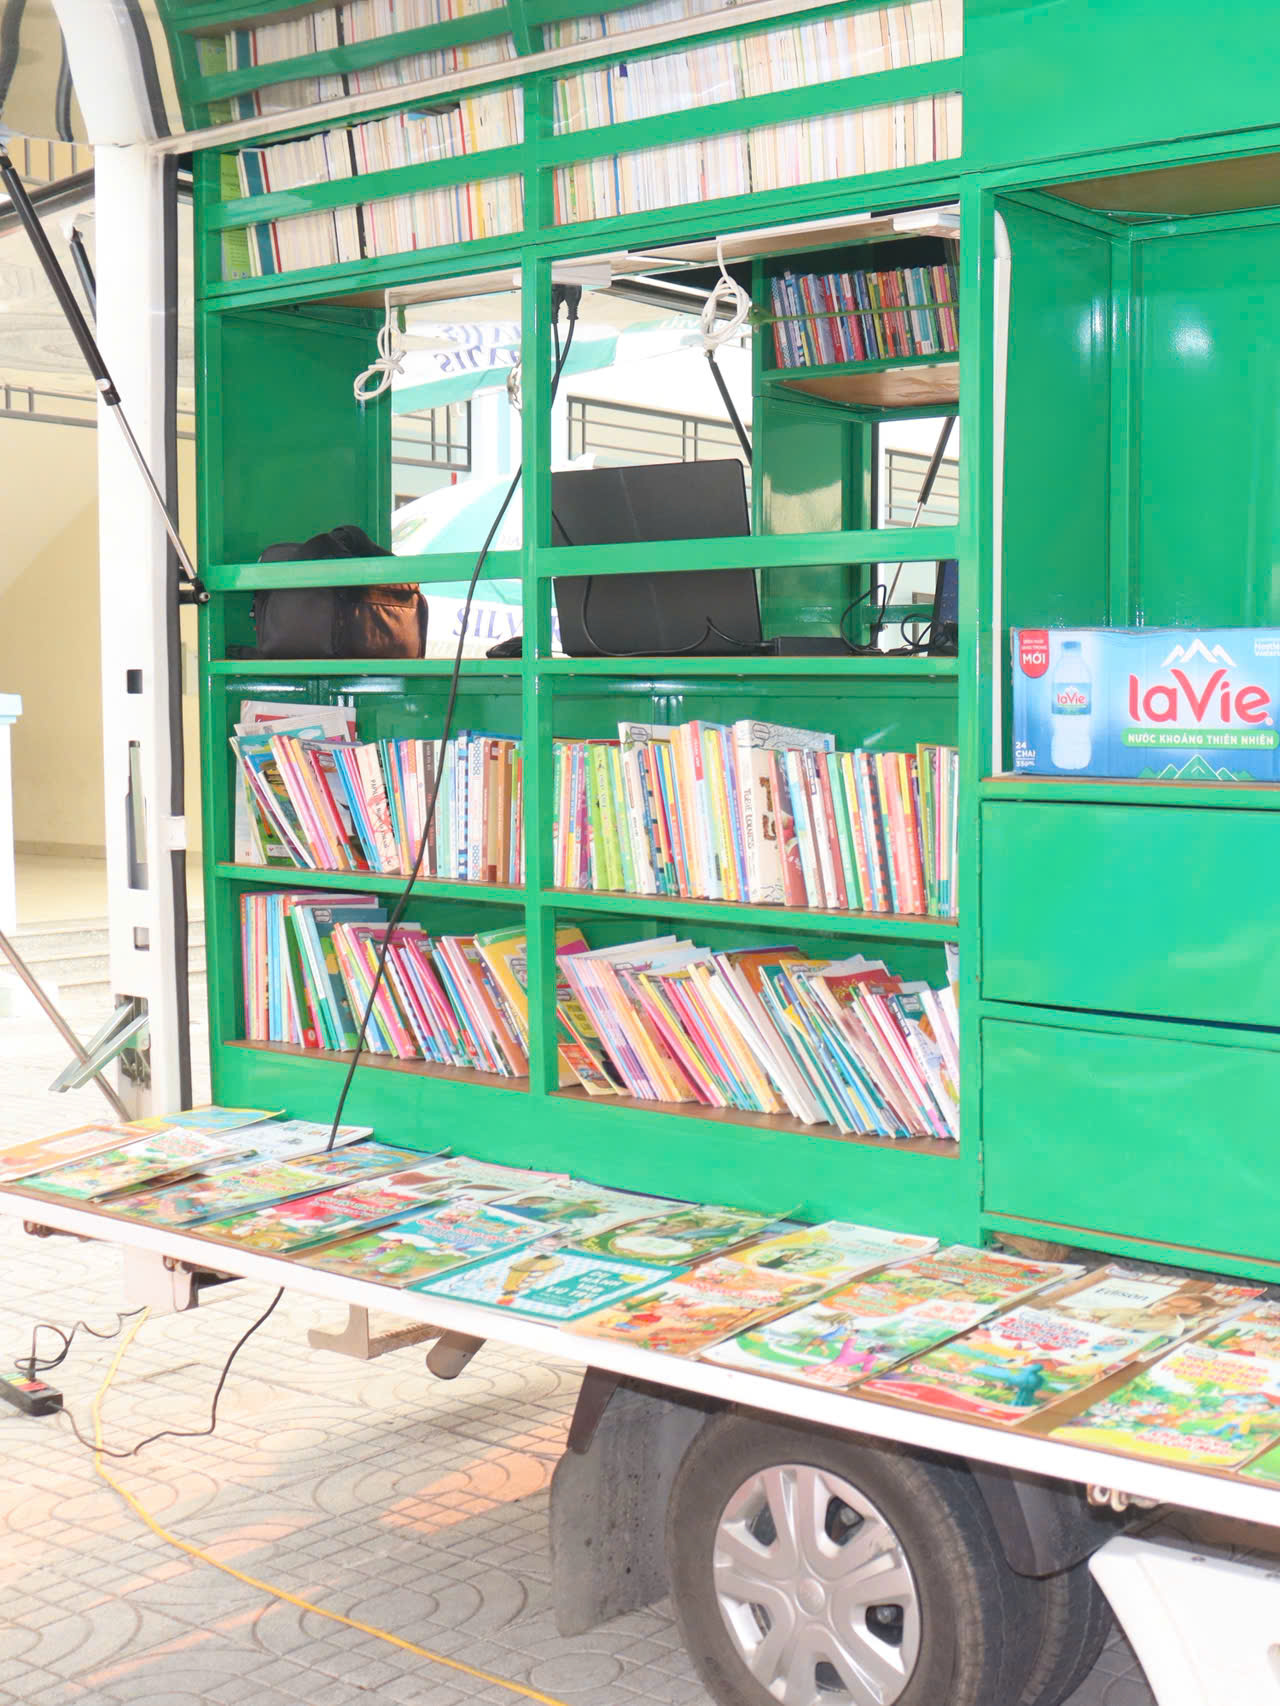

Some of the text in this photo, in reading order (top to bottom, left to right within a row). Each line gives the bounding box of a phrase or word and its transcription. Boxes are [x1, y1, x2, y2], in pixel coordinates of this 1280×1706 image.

[1022, 650, 1046, 665] MỚI
[1128, 668, 1272, 724] laVie
[1015, 741, 1027, 749] 24
[1159, 732, 1204, 745] KHOÁNG
[1207, 732, 1239, 745] THIÊN
[1241, 733, 1274, 746] NHIÊN
[1015, 749, 1036, 758] CHAI
